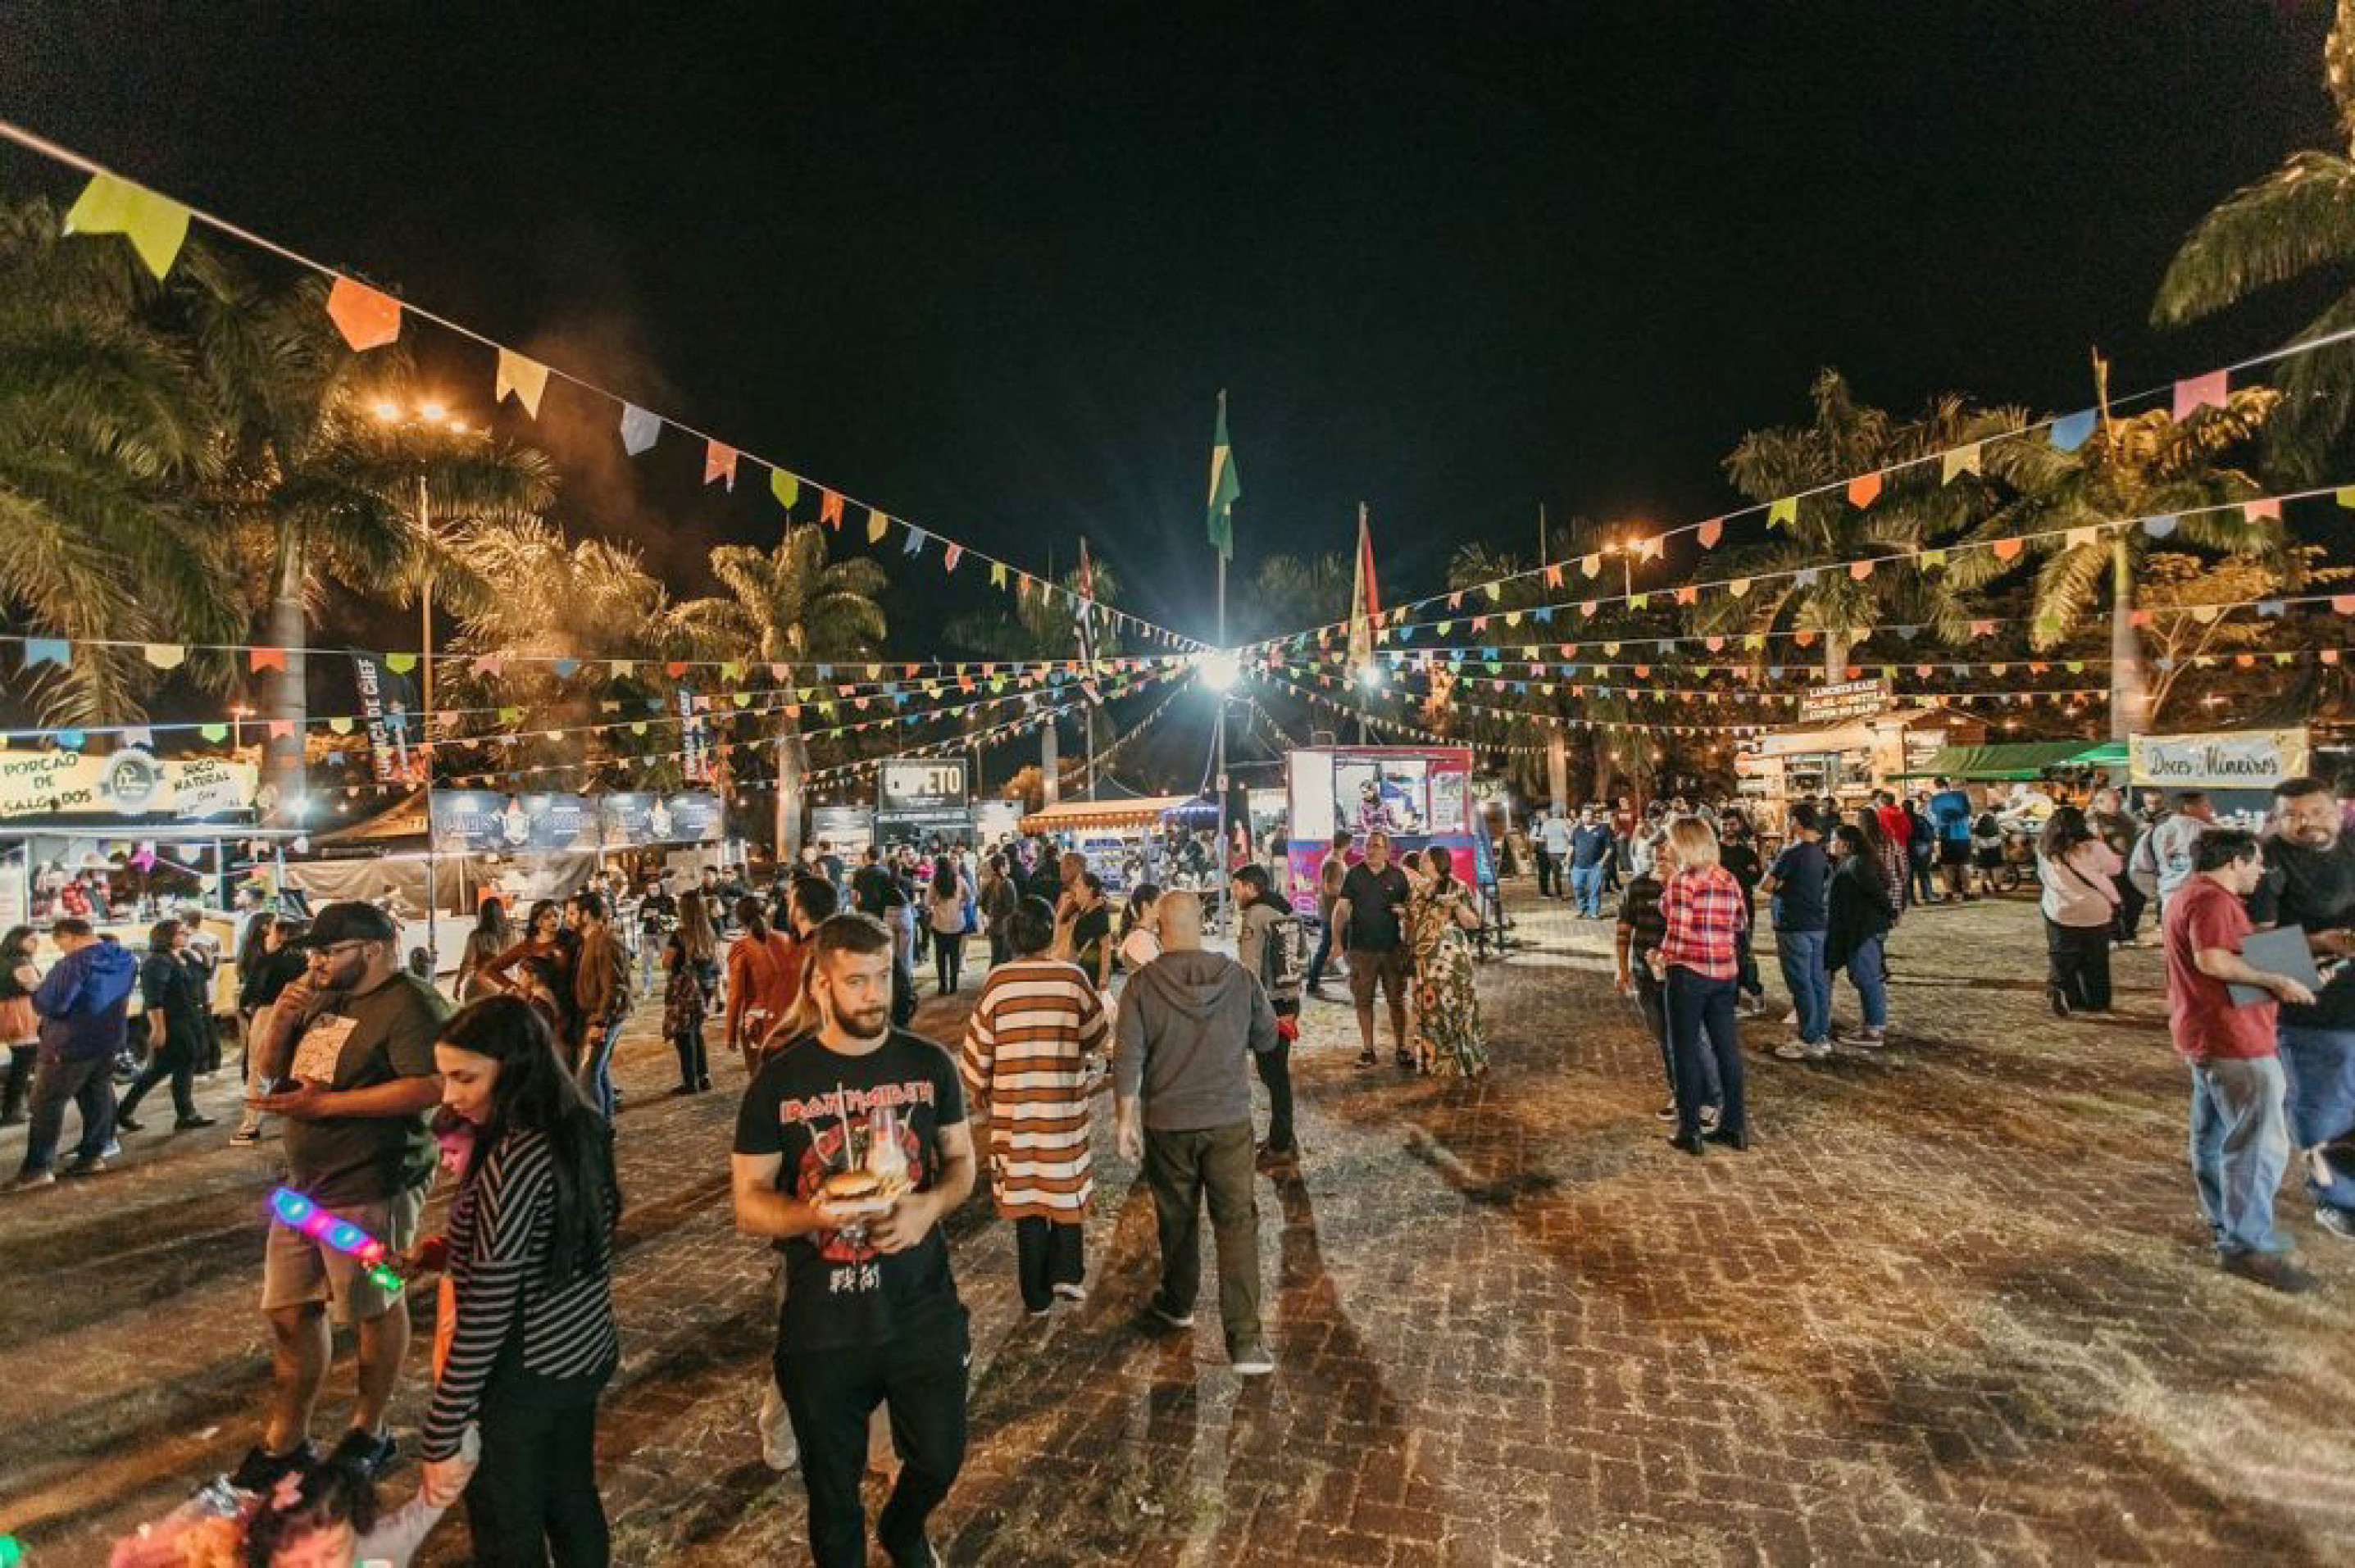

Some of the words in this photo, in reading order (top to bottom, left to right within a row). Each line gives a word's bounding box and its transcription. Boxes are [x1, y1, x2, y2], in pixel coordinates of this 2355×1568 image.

[357, 659, 379, 695] CHEF
[181, 757, 216, 776] SUCO
[2149, 747, 2192, 775] Doces
[2206, 745, 2278, 776] Mineiros
[33, 774, 57, 789] DE
[172, 770, 232, 793] NATURAL
[843, 1080, 934, 1116] MAIDEN
